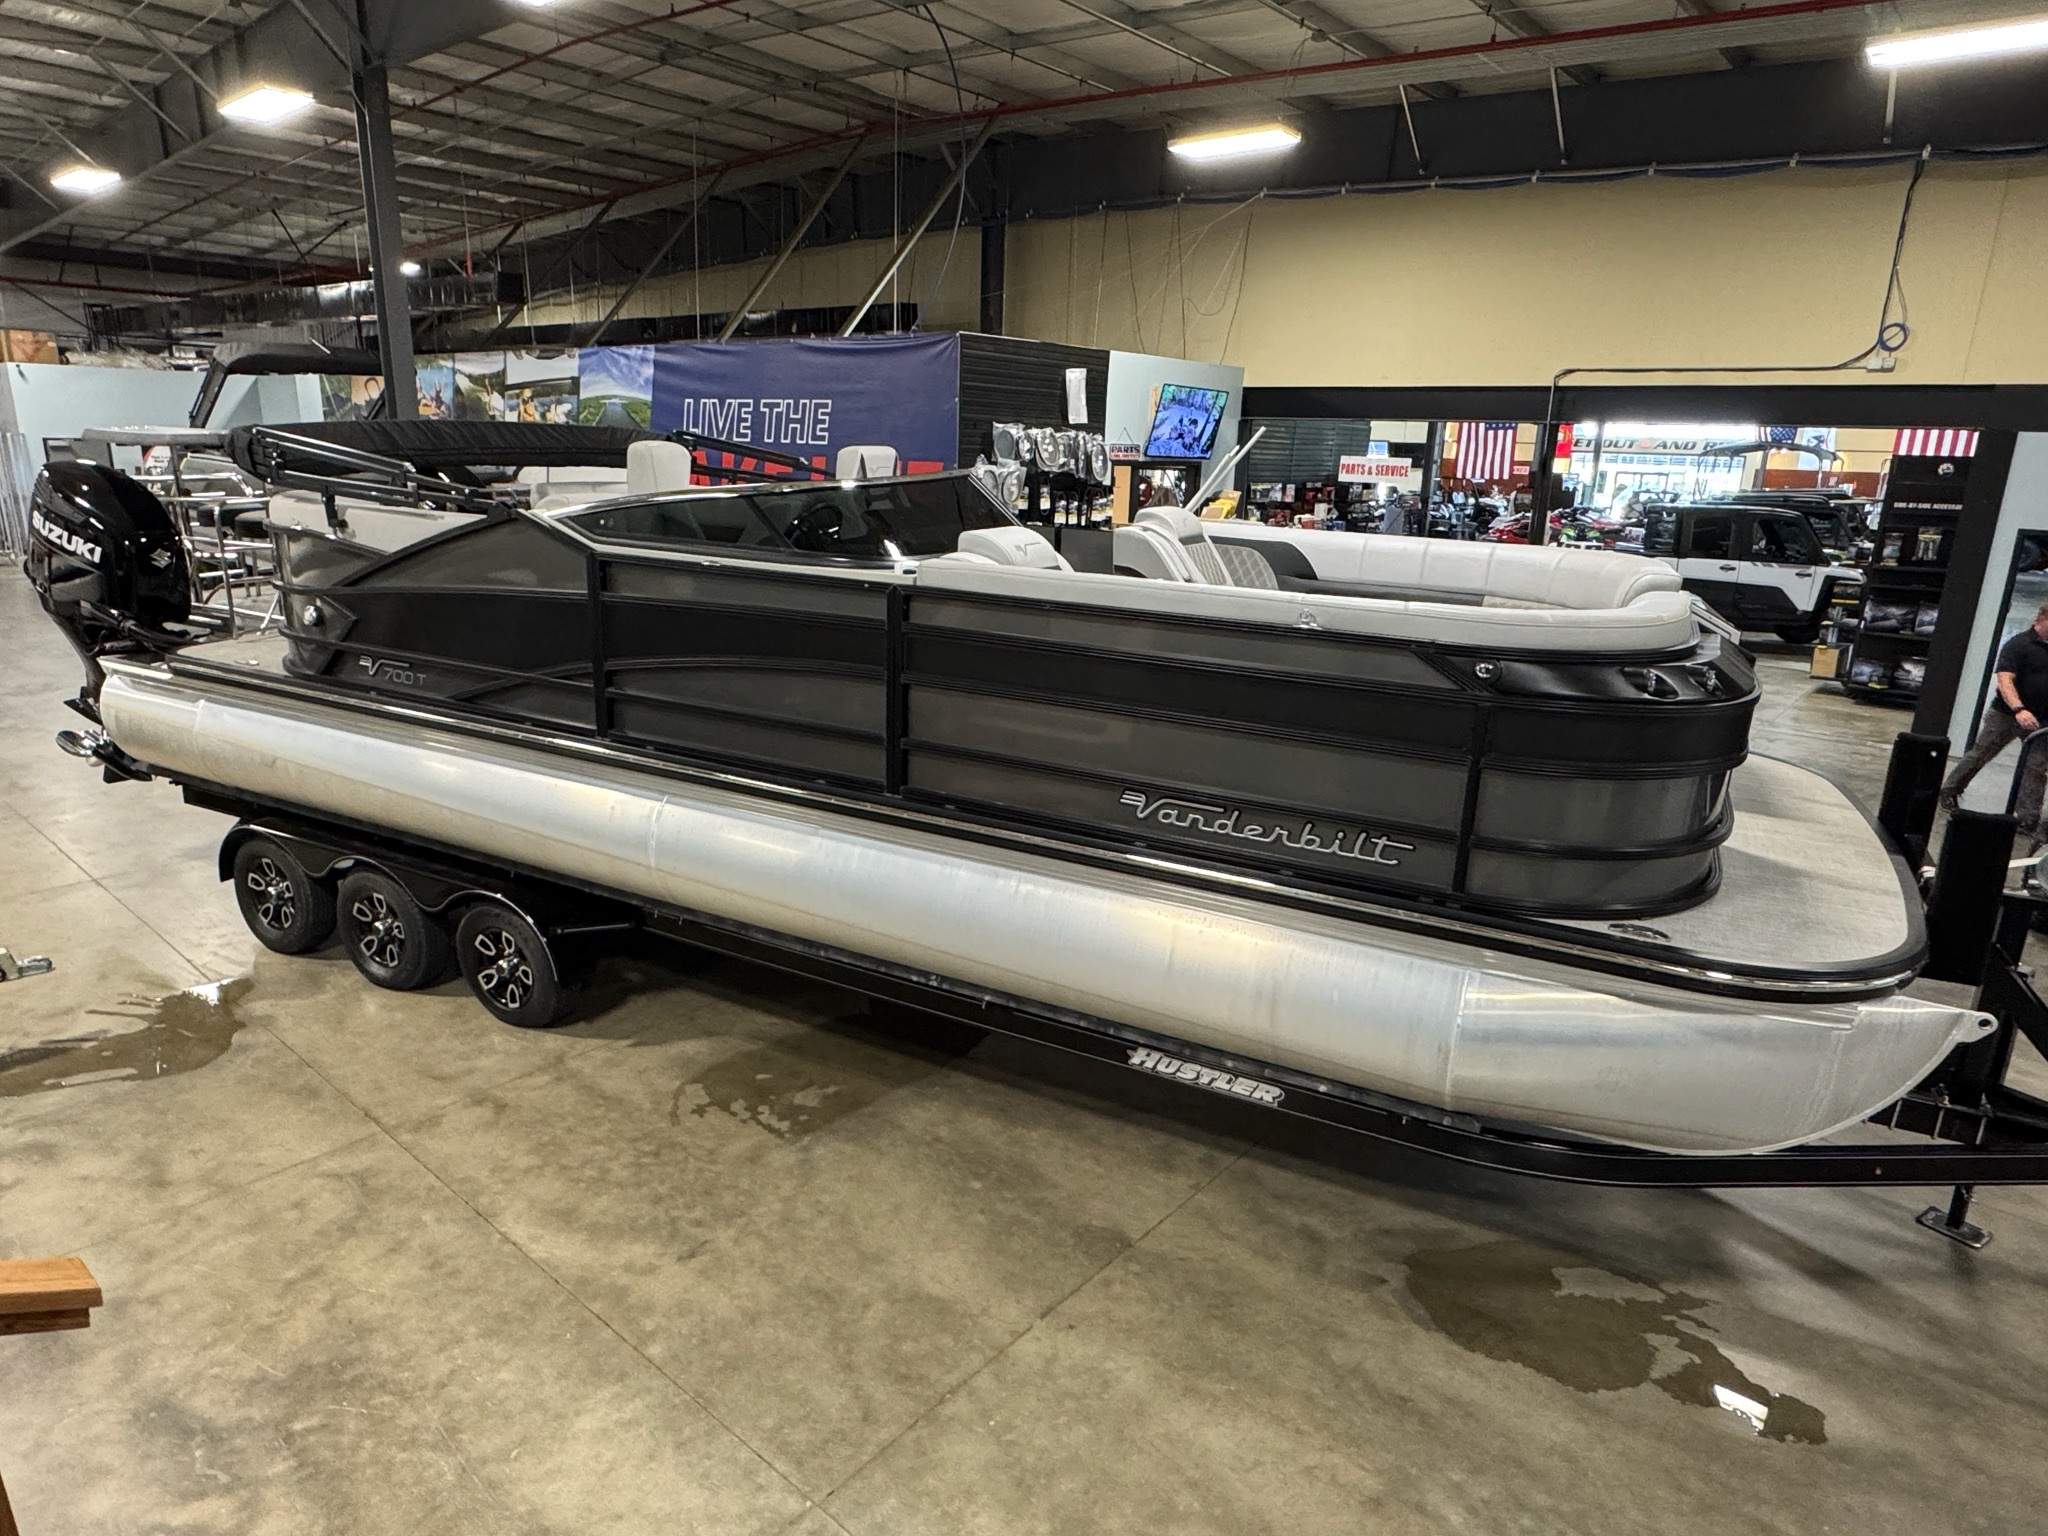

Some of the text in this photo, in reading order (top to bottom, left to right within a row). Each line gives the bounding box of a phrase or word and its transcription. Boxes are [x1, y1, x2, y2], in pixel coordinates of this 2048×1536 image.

[683, 398, 832, 445] LIVE THE
[1111, 445, 1141, 454] PARTS
[1572, 437, 1596, 448] ET
[1603, 438, 1639, 449] OUT
[1652, 440, 1698, 450] AND
[1340, 463, 1409, 477] PARTS & SERVICE
[32, 510, 102, 564] SUZUKI
[383, 666, 413, 685] 700
[416, 673, 426, 686] T
[1119, 790, 1415, 865] Vanderbilt
[1127, 1046, 1285, 1107] HUSTLER
